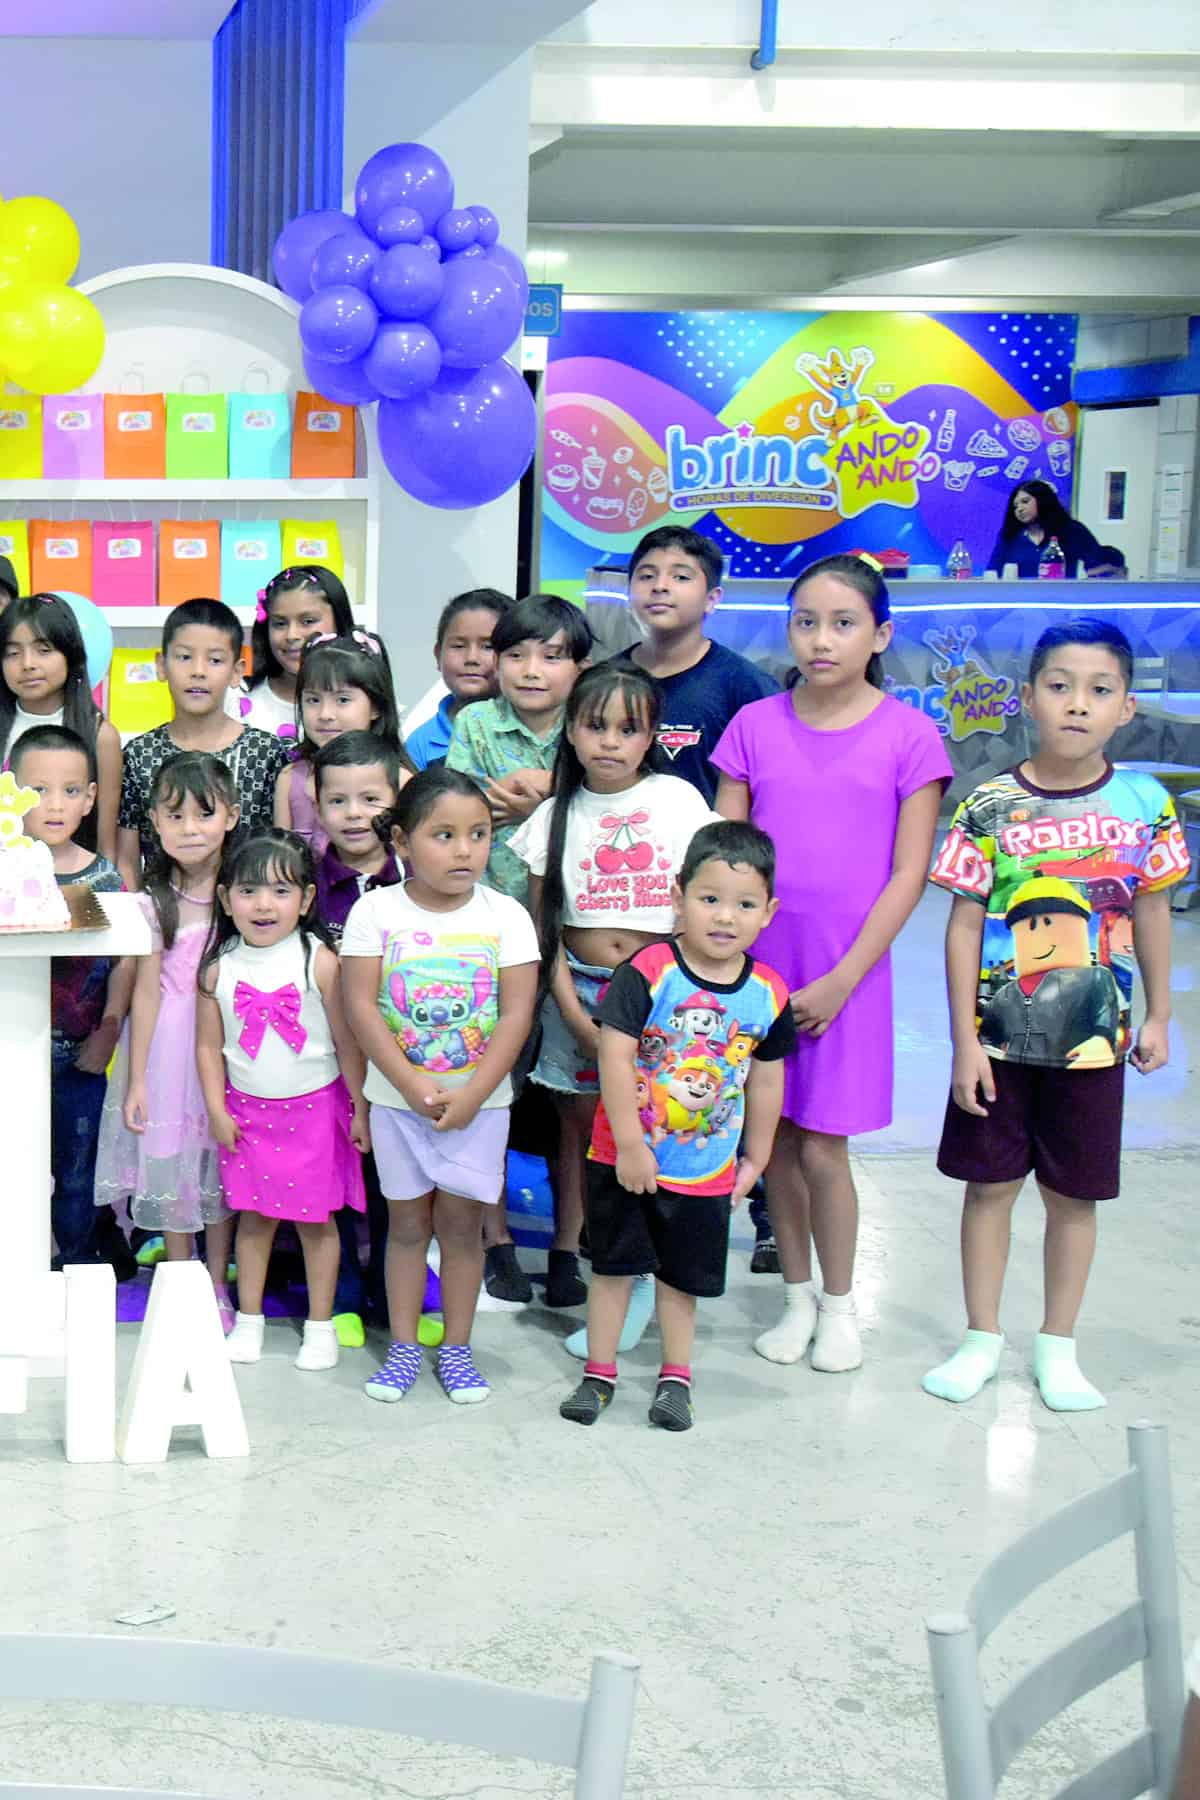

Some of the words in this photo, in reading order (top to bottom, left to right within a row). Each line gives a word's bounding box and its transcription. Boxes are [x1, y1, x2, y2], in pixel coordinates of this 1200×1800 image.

[668, 429, 829, 491] brinc
[835, 425, 920, 472] ANDO
[856, 455, 938, 491] ANDO
[950, 677, 1008, 708] ANDO
[963, 697, 1021, 722] ANDO
